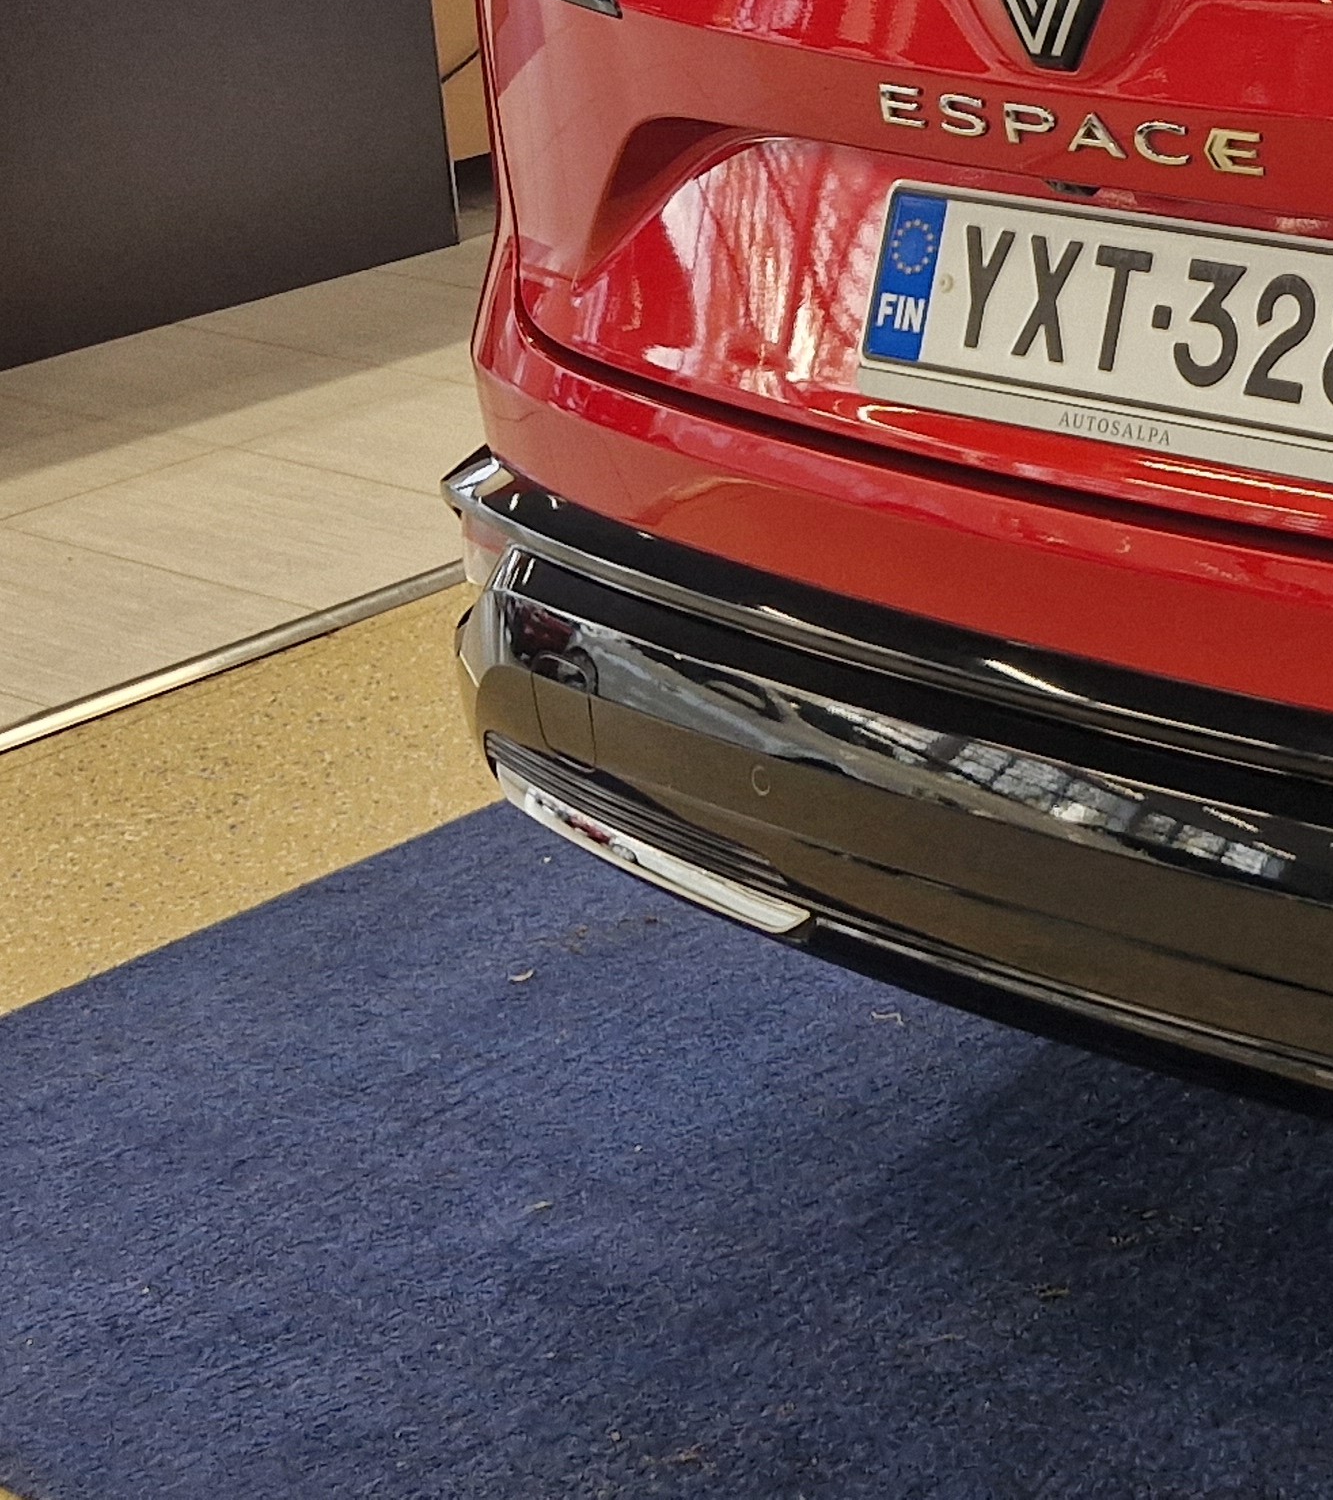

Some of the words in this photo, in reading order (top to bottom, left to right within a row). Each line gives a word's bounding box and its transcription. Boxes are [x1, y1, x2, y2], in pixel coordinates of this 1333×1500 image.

[878, 83, 1265, 177] ESPACE
[875, 291, 926, 334] FIN
[1058, 410, 1171, 447] AUTOSALPA
